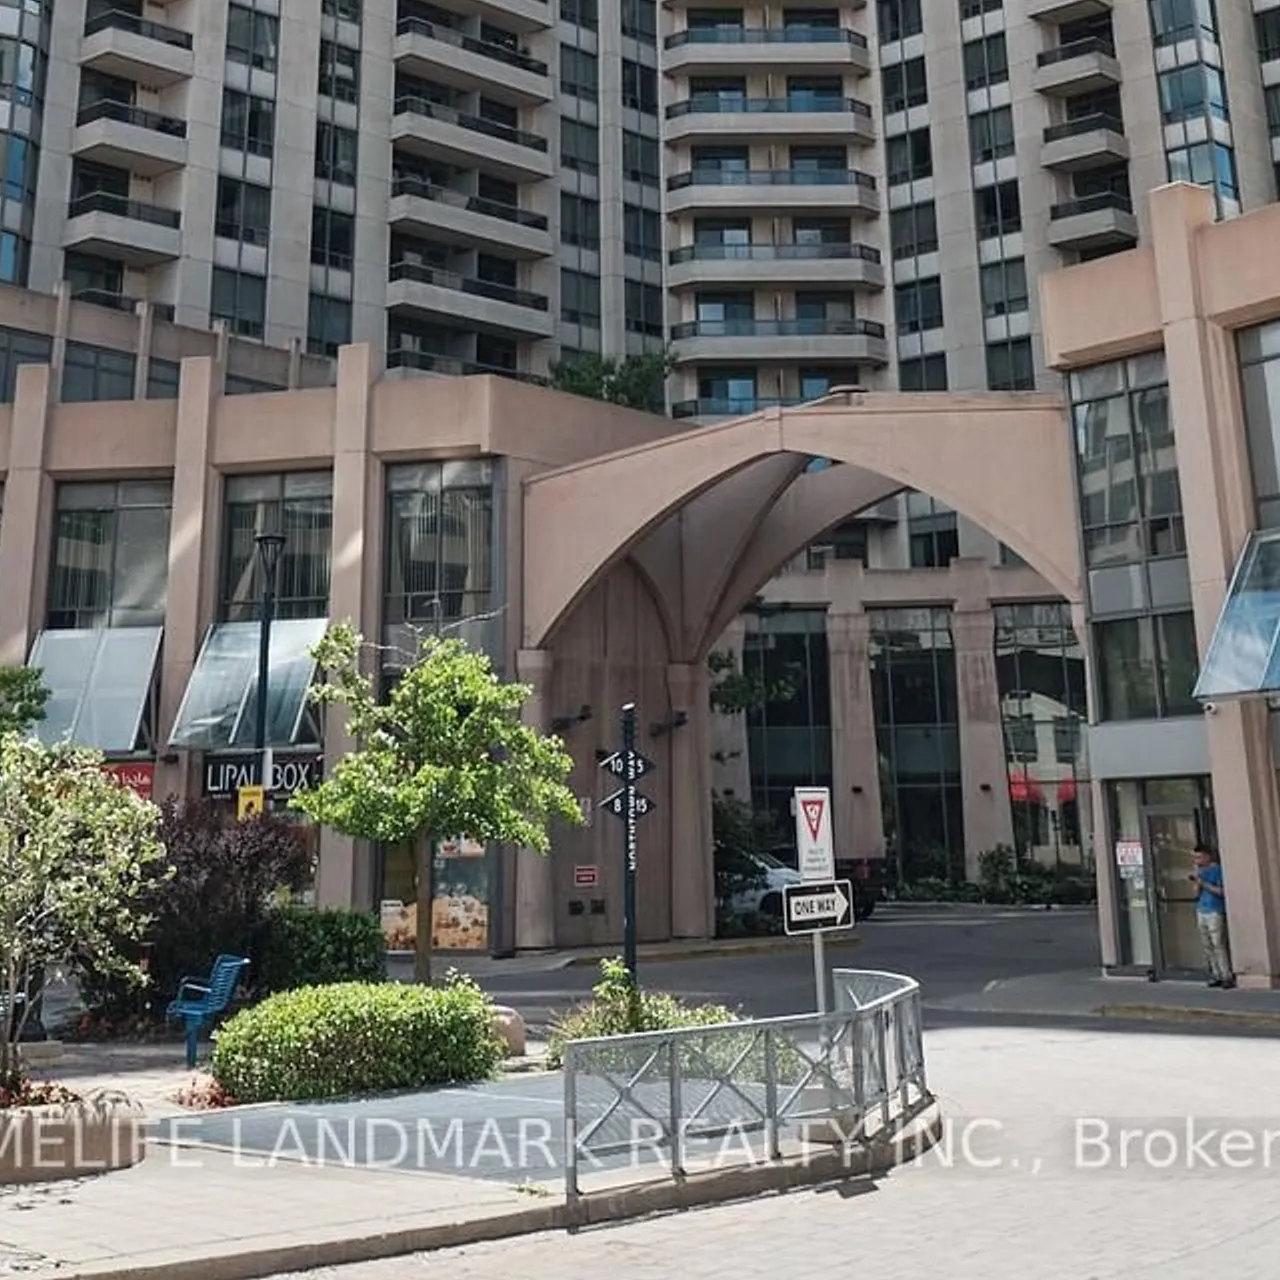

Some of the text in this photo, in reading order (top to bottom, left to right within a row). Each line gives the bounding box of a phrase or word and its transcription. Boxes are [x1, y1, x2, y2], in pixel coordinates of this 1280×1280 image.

[610, 759, 624, 772] 10
[636, 760, 644, 773] 5
[794, 898, 836, 915] ONE WAY
